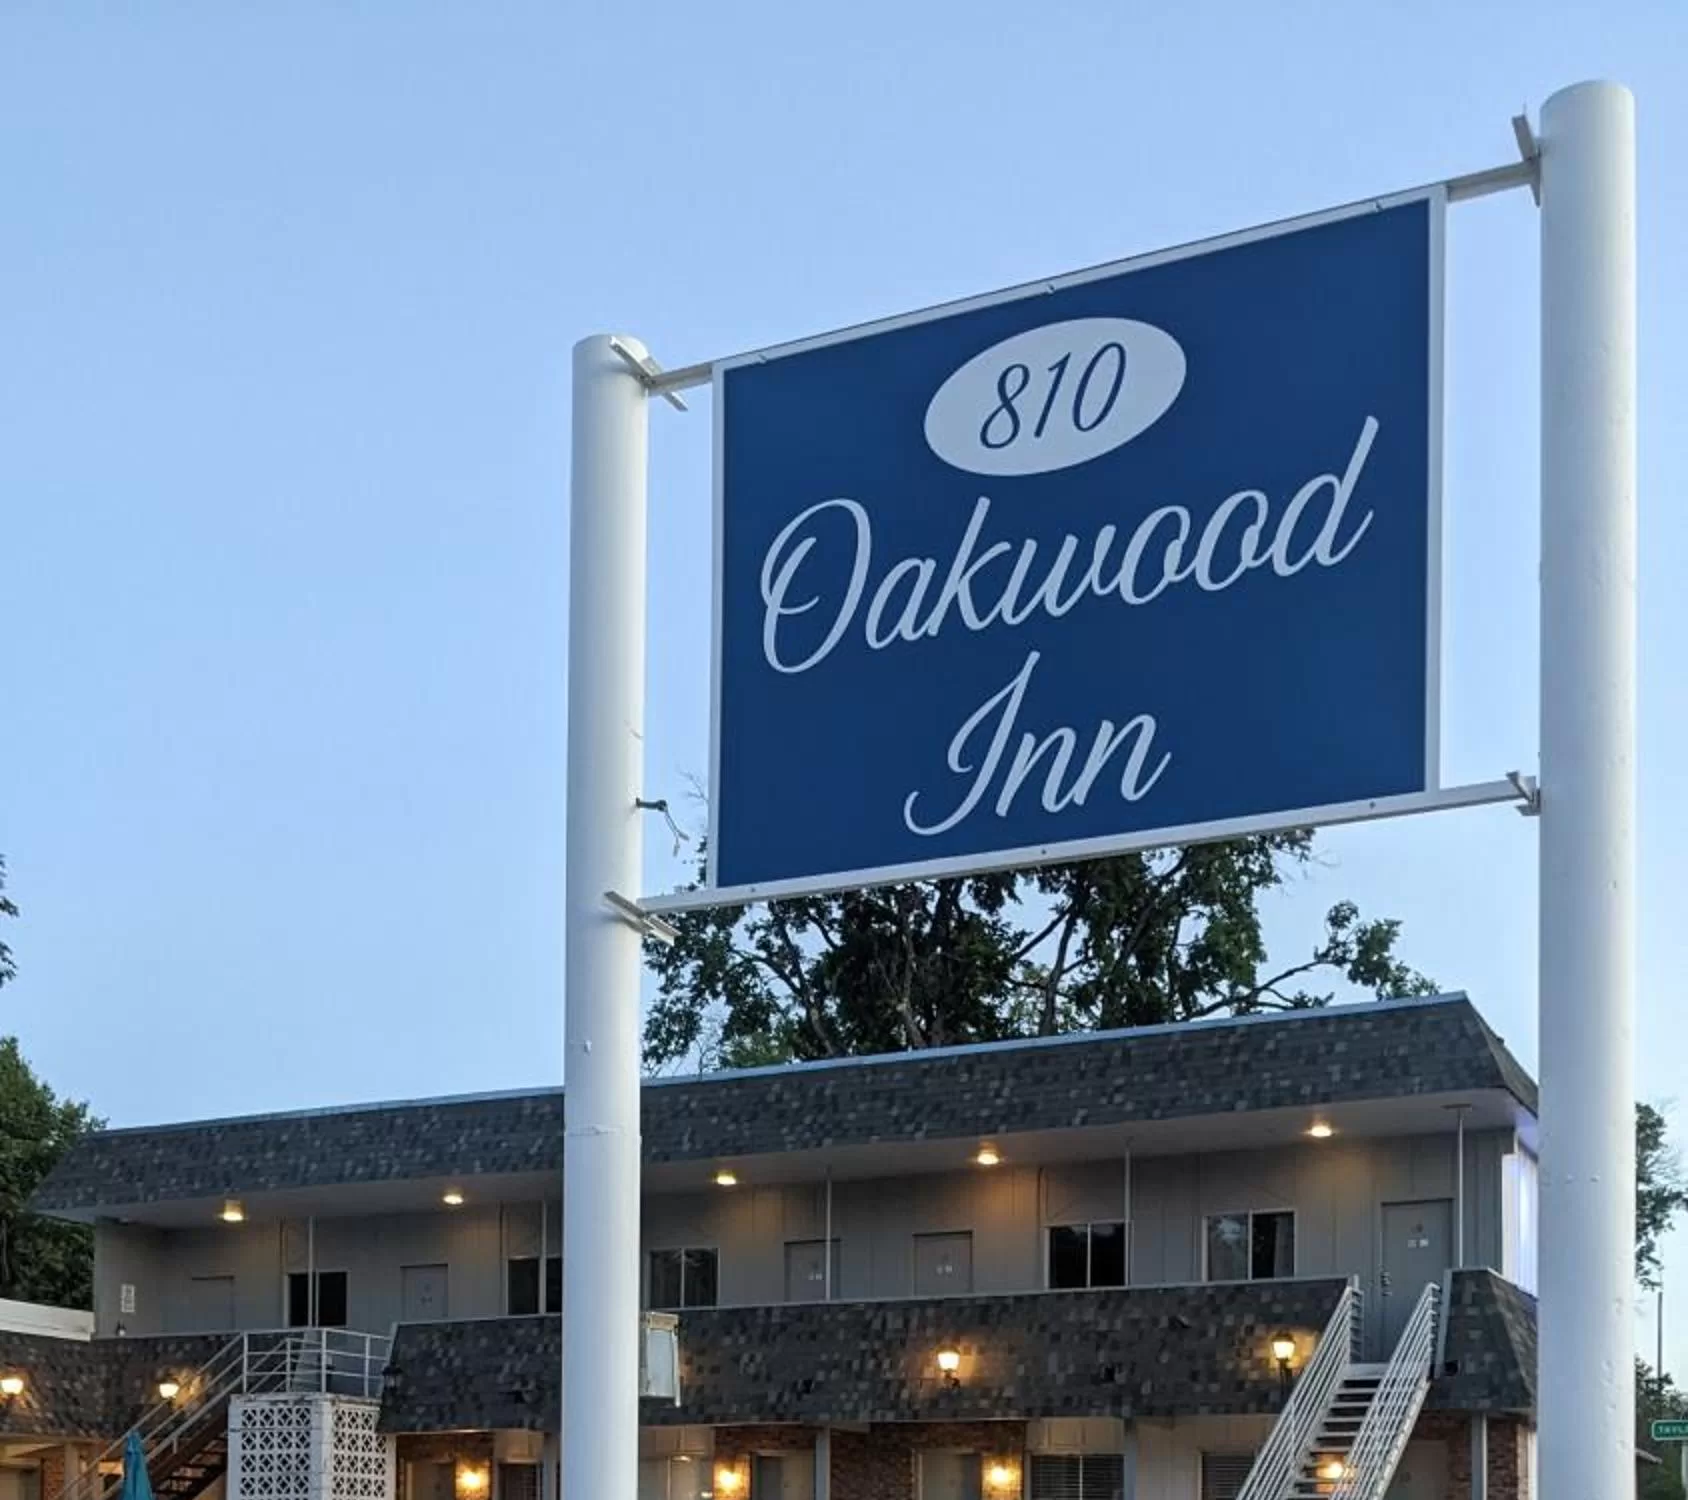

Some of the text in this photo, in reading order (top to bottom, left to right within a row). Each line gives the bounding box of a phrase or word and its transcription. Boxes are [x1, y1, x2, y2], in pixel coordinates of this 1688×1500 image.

[979, 341, 1127, 450] 810
[760, 415, 1380, 673] Oakwood
[903, 651, 1172, 836] Inn
